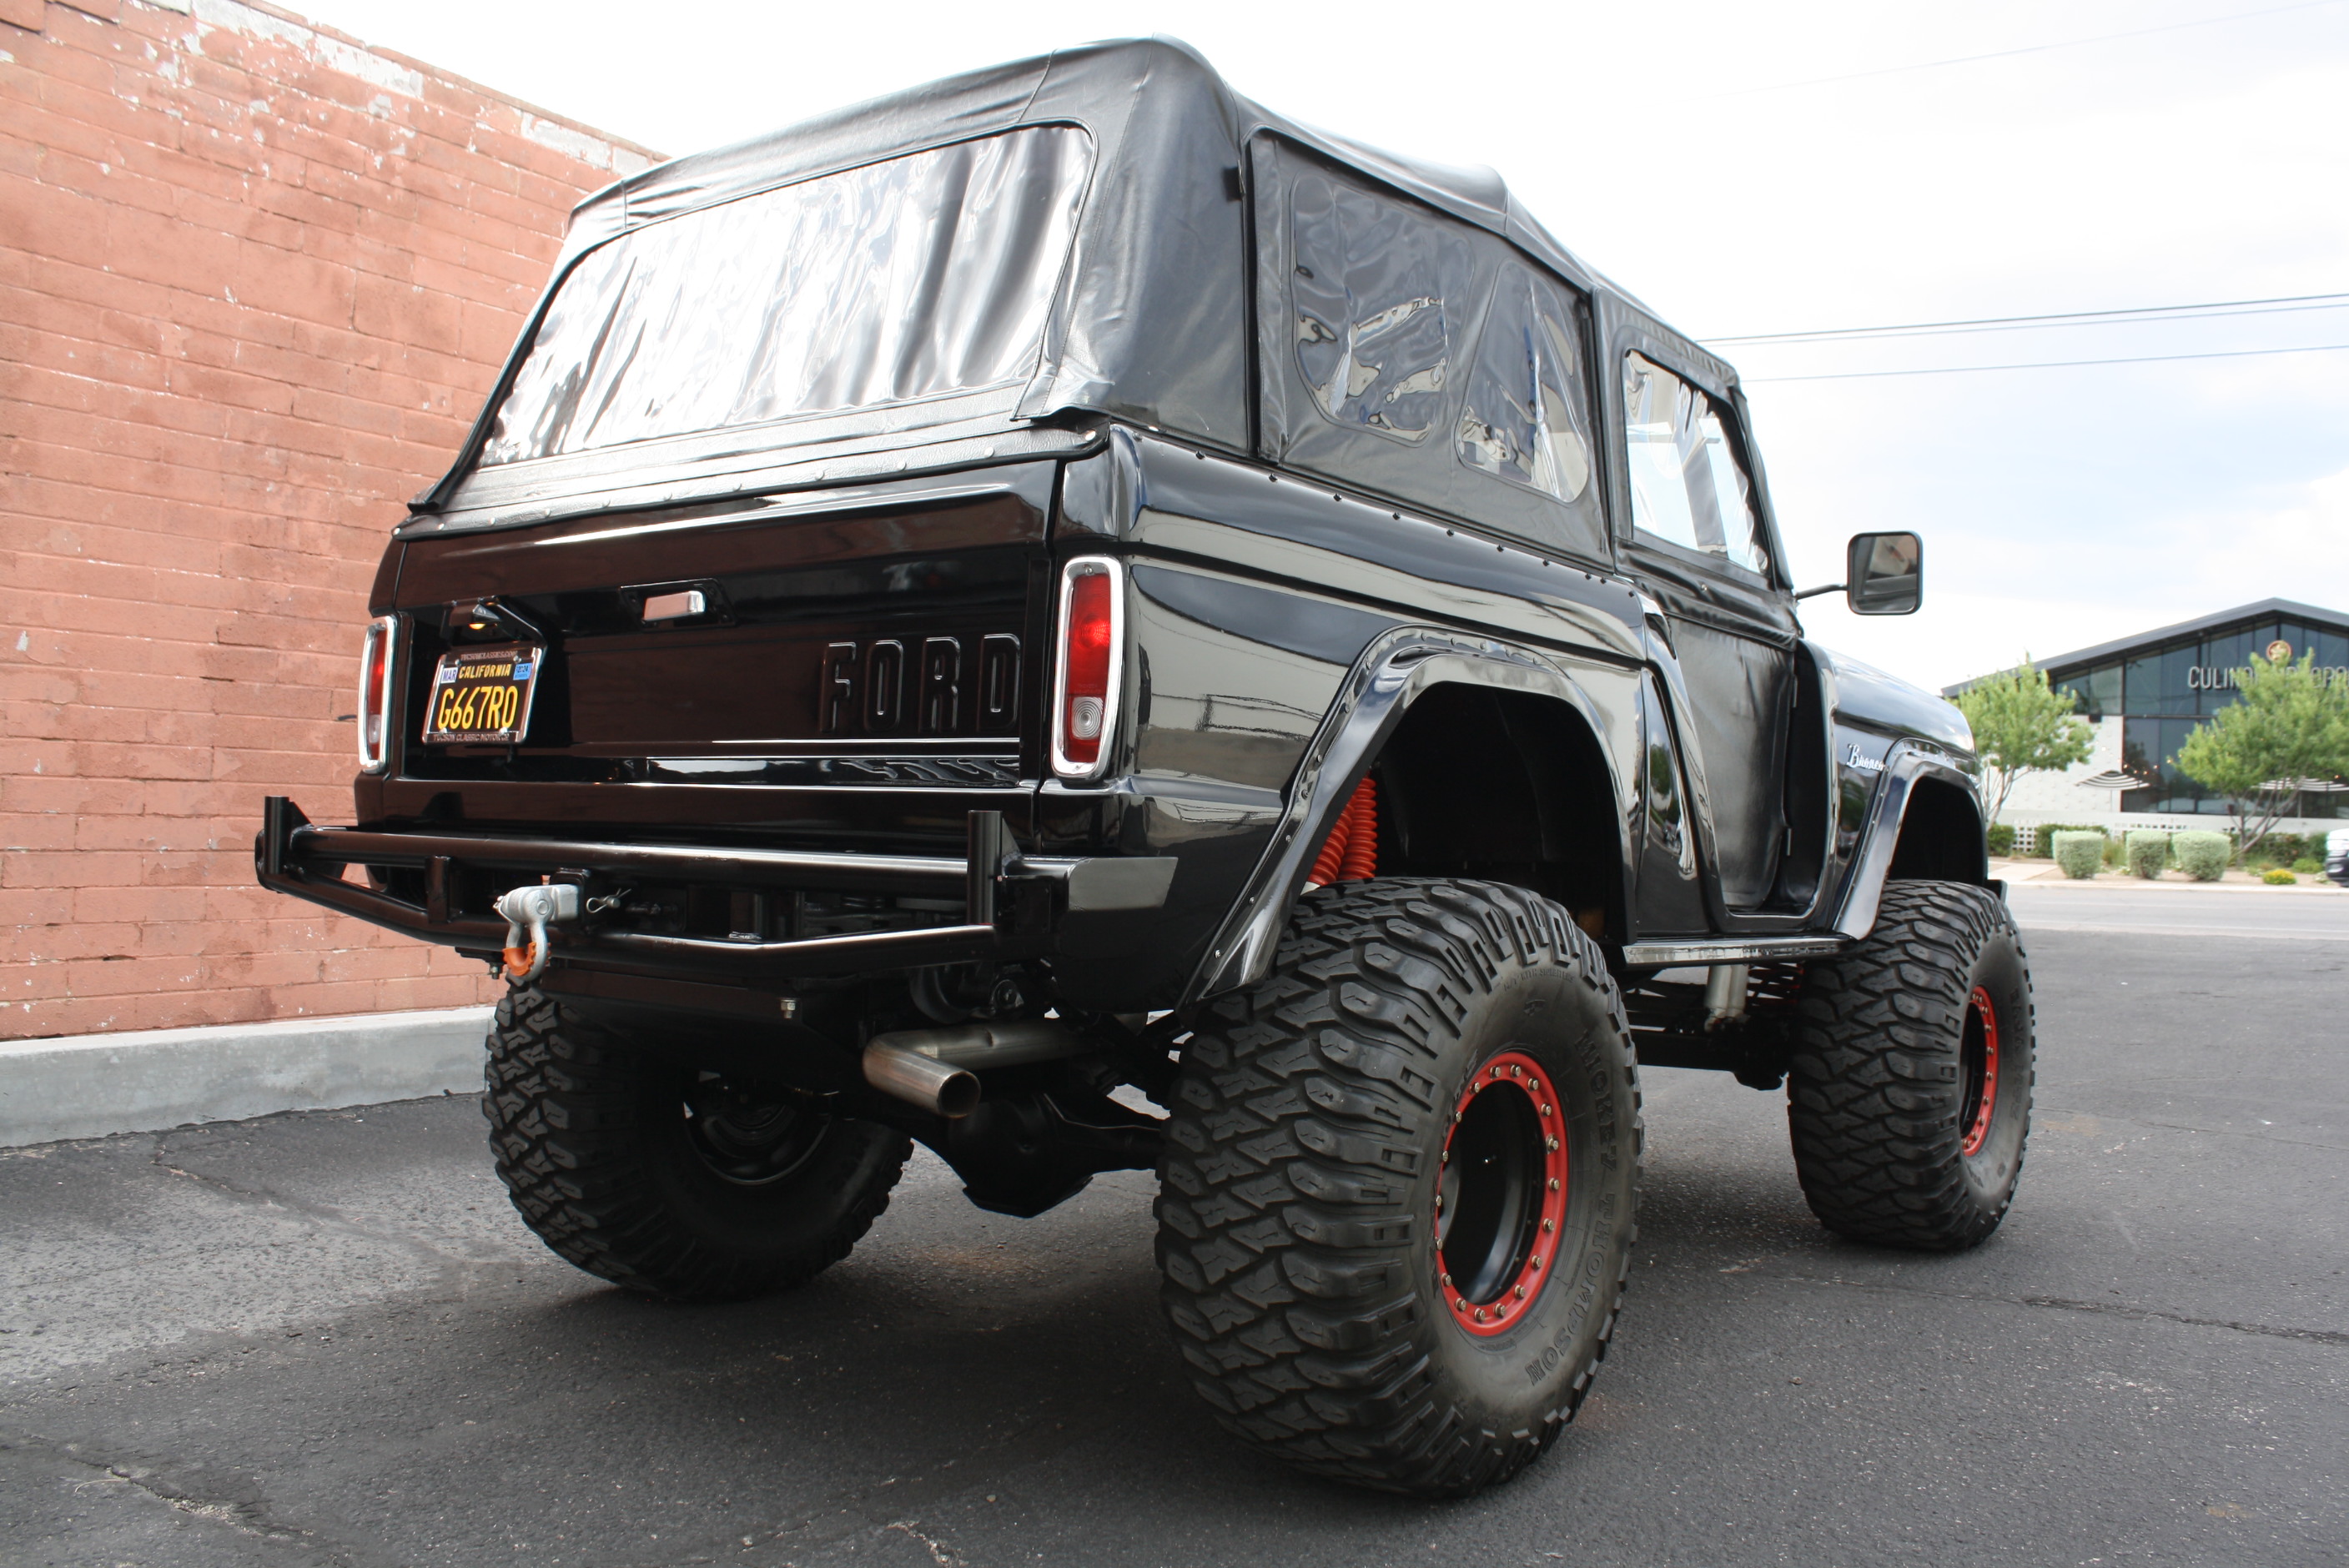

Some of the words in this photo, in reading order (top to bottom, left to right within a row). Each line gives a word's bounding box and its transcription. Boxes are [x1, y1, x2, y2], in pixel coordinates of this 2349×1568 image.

[442, 669, 457, 681] MAR
[459, 663, 512, 679] CALIFORNIA
[820, 633, 1020, 733] FORD
[456, 733, 480, 741] CLASSIC
[1574, 1028, 1617, 1172] MICKEY
[1525, 1193, 1616, 1386] THOMPSON
